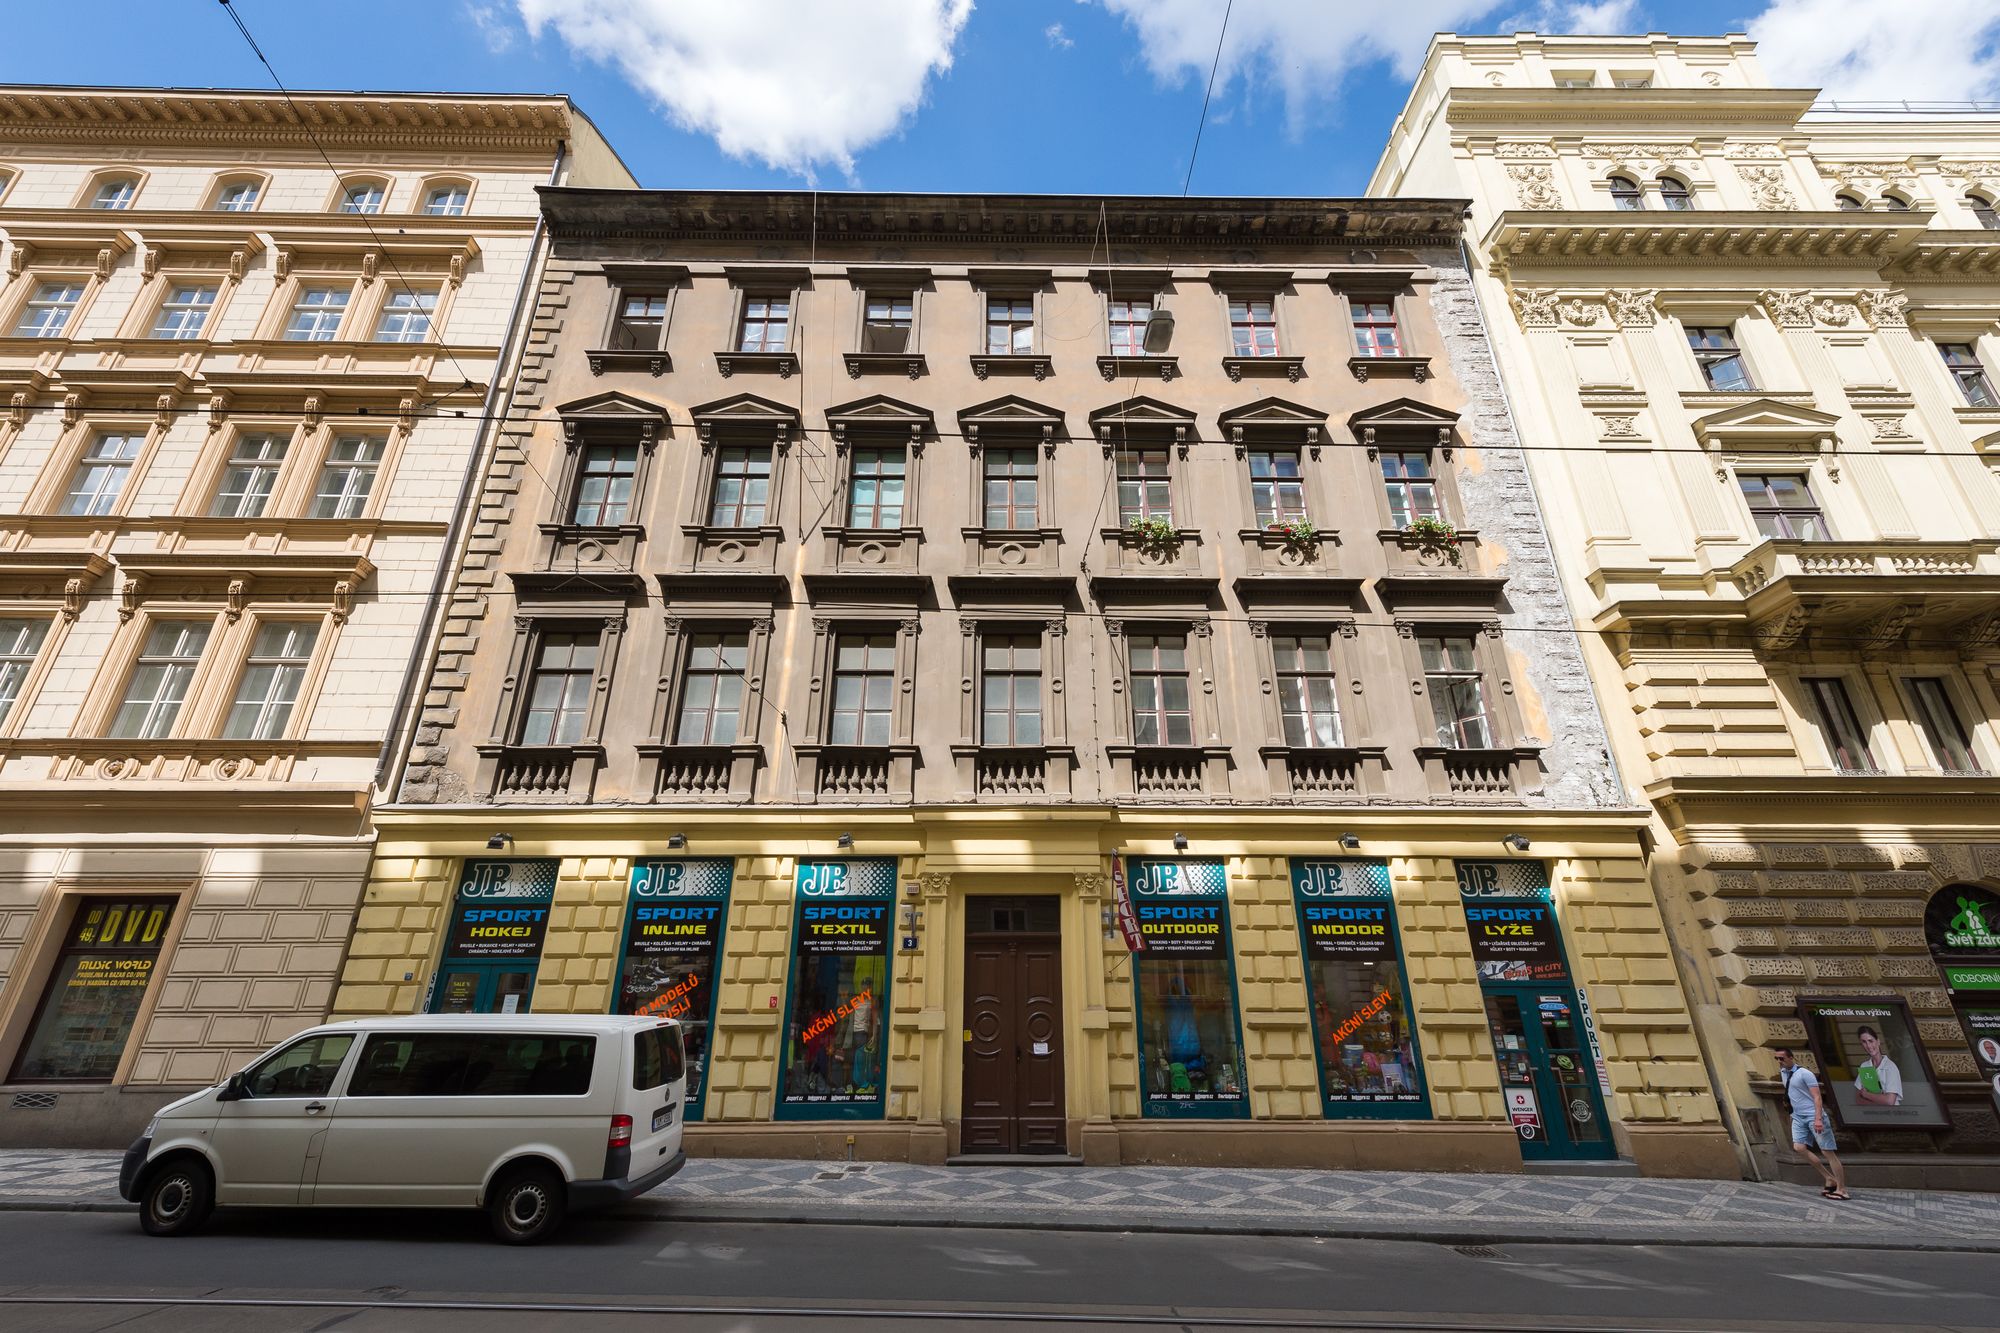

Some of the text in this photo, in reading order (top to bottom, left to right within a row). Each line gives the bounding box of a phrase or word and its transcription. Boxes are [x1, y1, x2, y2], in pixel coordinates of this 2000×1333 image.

[463, 863, 513, 897] JB
[637, 862, 687, 896] JB
[802, 861, 852, 896] JB
[1136, 861, 1184, 894] JB
[1300, 862, 1348, 896] JB
[1459, 864, 1505, 897] JB
[87, 911, 102, 924] OD
[464, 909, 546, 922] SPORT
[636, 908, 719, 920] SPORT
[804, 907, 885, 919] SPORT
[1140, 907, 1219, 919] SPORT
[1305, 908, 1385, 920] SPORT
[1466, 909, 1544, 920] SPORT
[100, 911, 164, 942] DVD
[470, 927, 531, 937] HOKEJ
[643, 925, 707, 935] INLINE
[811, 924, 876, 934] TEXTIL
[1142, 924, 1219, 934] OUTDOOR
[1311, 925, 1385, 935] INDOOR
[1484, 923, 1534, 935] LYŽE
[907, 939, 913, 947] 3
[1946, 932, 1974, 945] Svět
[78, 960, 152, 970] MUSIC WORLD
[1544, 963, 1561, 971] CITY
[423, 972, 436, 1013] SPO
[649, 973, 699, 1011] MODELŮ
[802, 989, 871, 1044] AKČNÍ SLEVY
[1332, 990, 1392, 1045] AKČNÍ SLEVY
[1865, 1009, 1892, 1017] výživu
[1579, 989, 1601, 1058] SPORT
